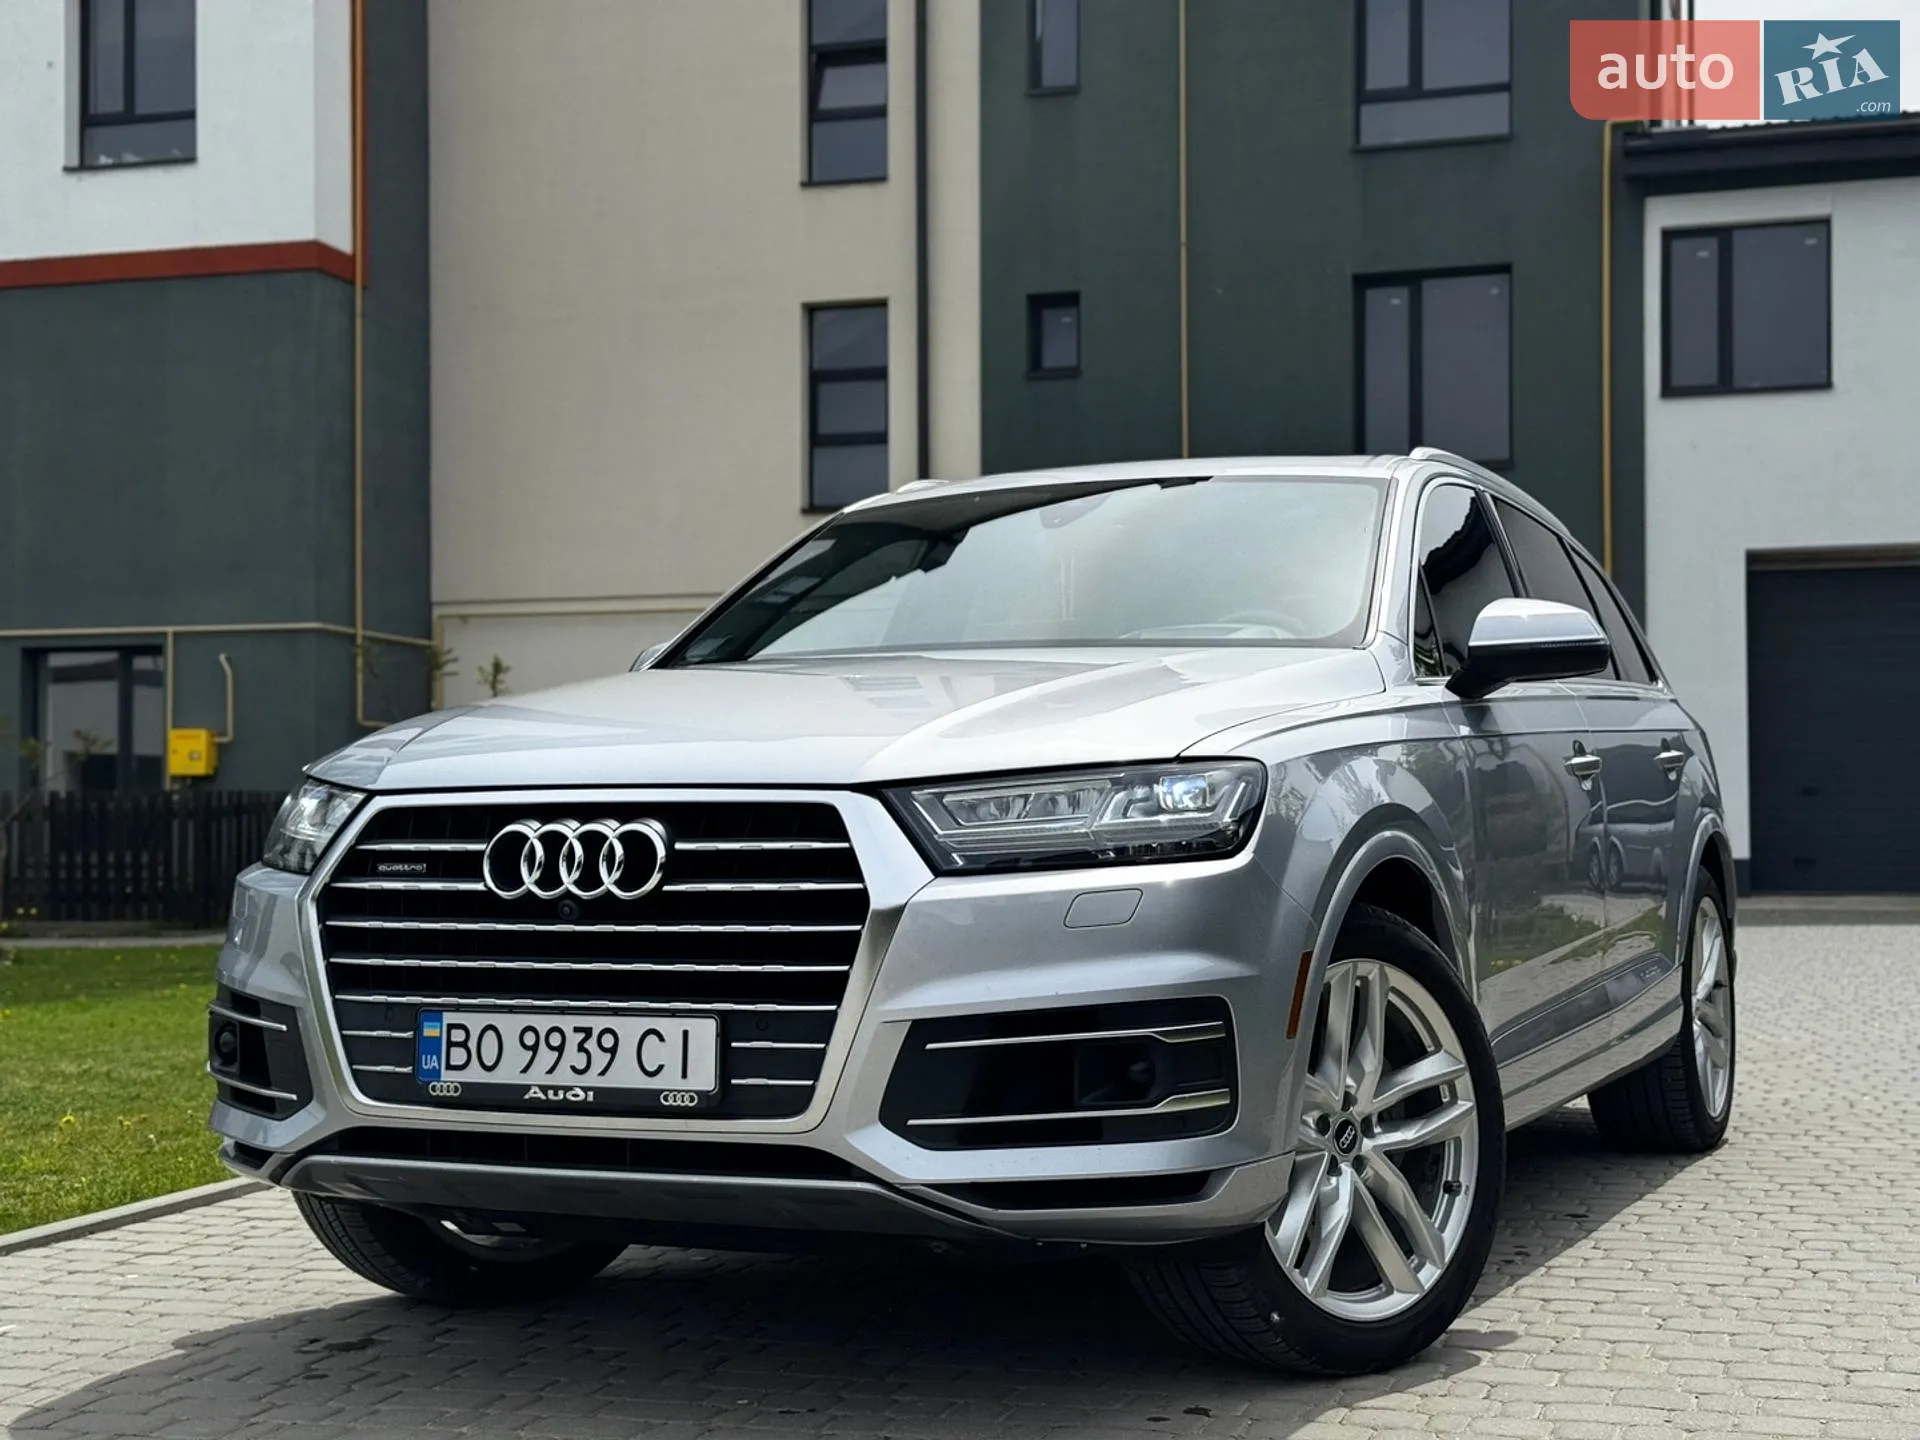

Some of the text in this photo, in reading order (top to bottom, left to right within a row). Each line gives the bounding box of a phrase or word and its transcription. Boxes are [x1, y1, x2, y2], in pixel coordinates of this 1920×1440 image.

[445, 1023, 689, 1079] BO 9939 CI
[421, 1054, 439, 1070] UA
[523, 1086, 594, 1101] Audi
